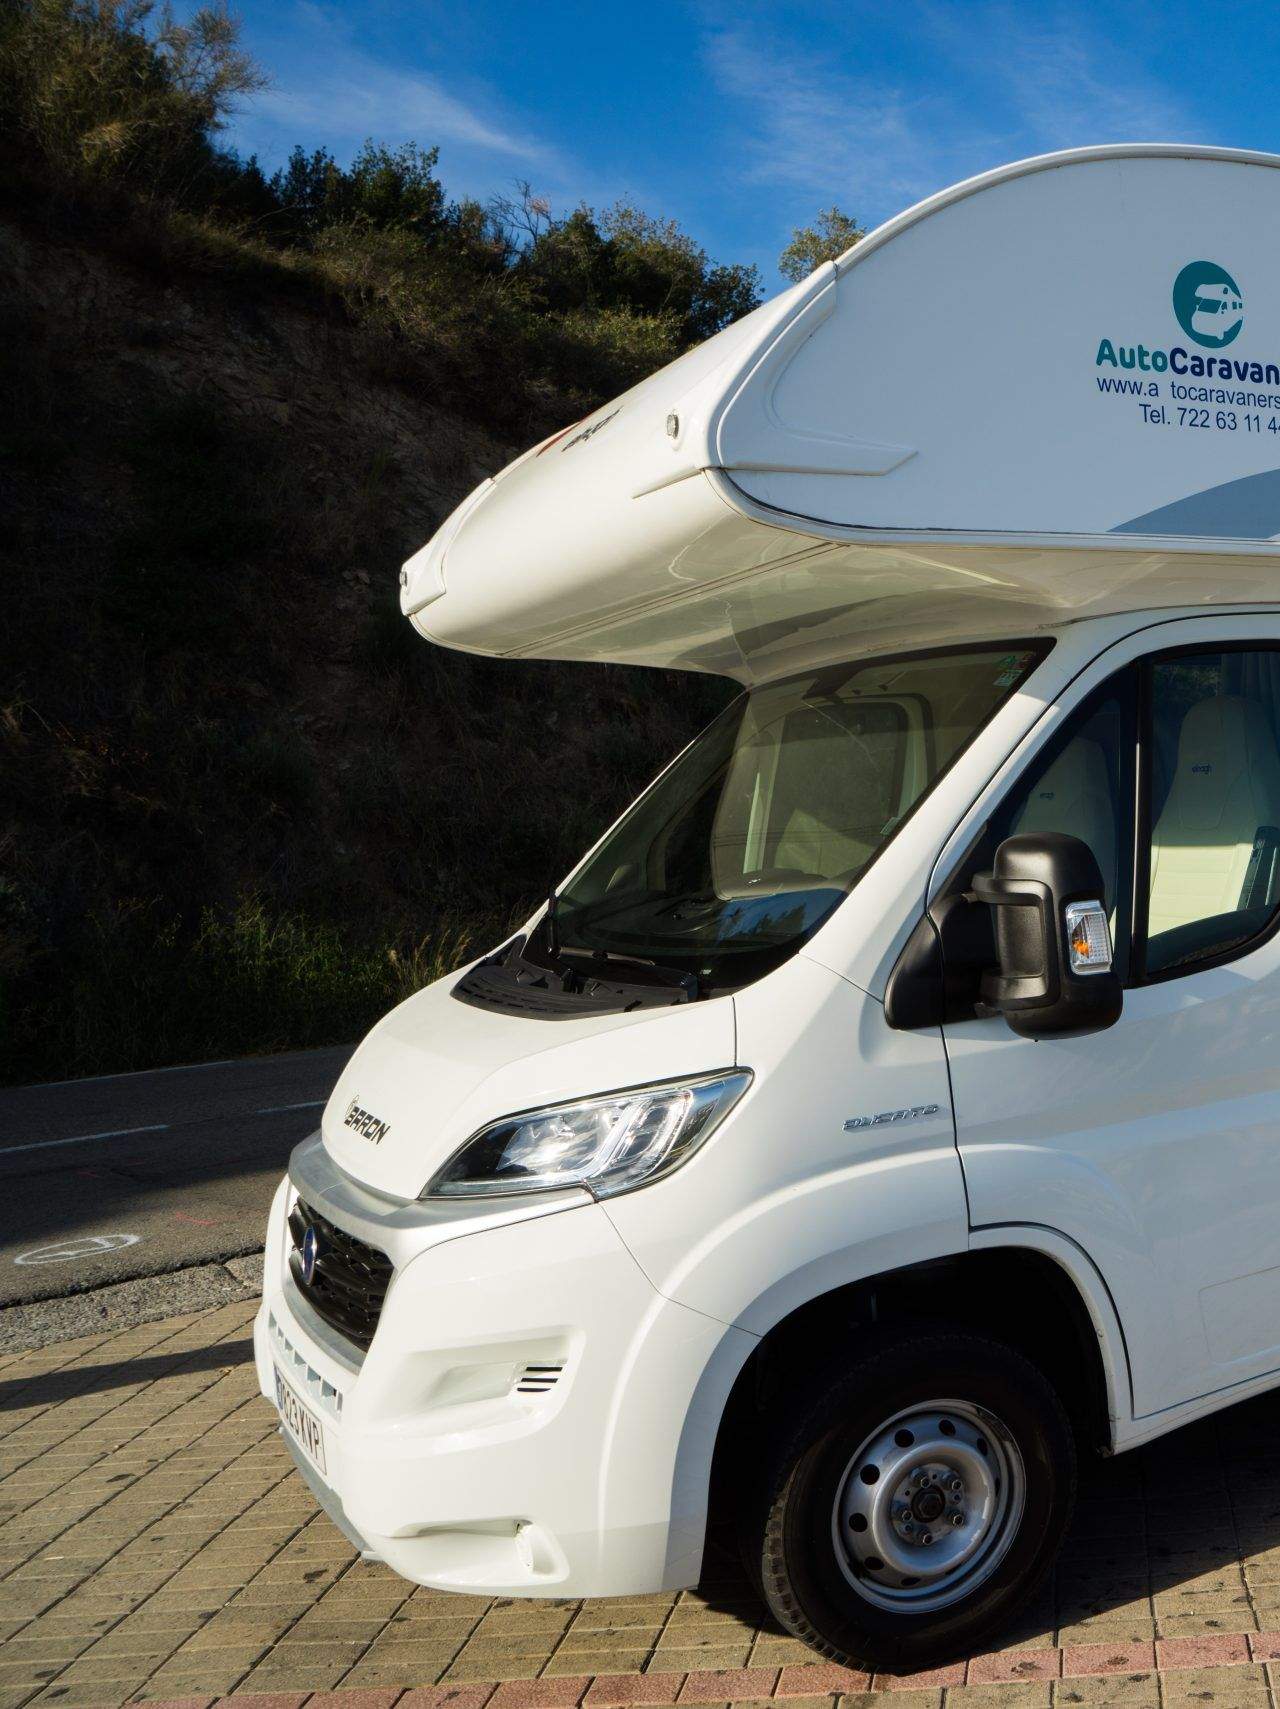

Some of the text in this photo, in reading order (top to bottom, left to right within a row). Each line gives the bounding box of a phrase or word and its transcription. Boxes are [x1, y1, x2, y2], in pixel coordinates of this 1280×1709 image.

[1139, 403, 1171, 425] Tel.
[1177, 407, 1210, 428] 722
[1216, 411, 1237, 431] 63
[1244, 414, 1260, 433] 11
